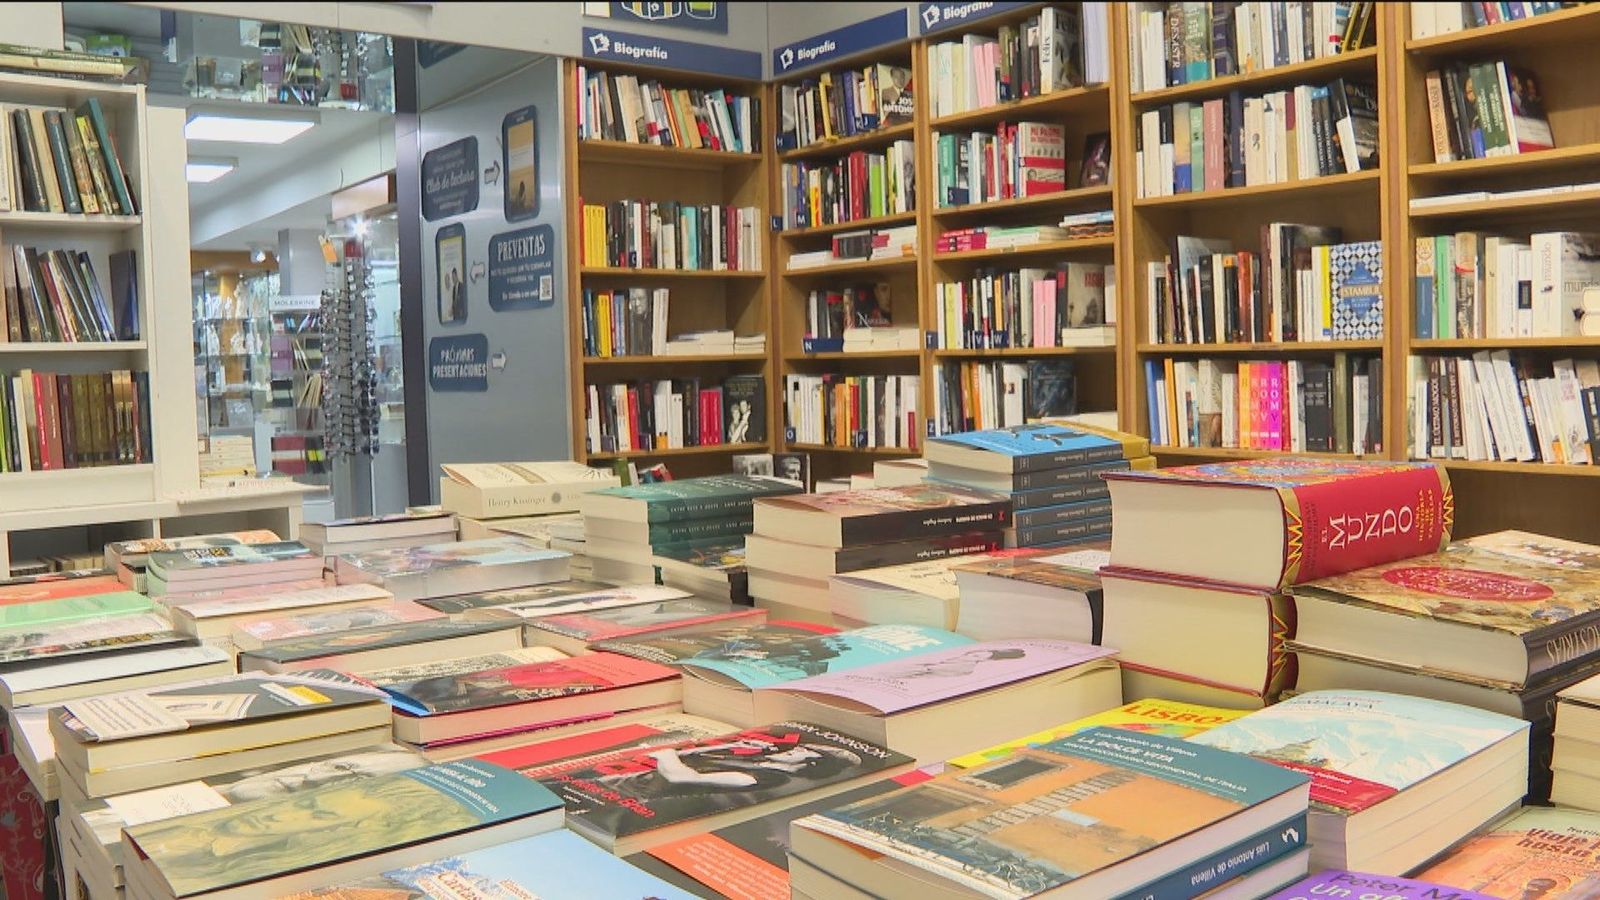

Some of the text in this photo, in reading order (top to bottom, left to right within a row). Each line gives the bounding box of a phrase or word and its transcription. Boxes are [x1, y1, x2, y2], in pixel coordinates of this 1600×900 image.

[614, 41, 668, 60] Biografía
[797, 40, 836, 61] Biografía
[883, 103, 914, 112] ANTONI
[898, 97, 912, 105] JOS
[777, 137, 783, 146] H
[773, 218, 778, 228] L
[797, 215, 806, 224] M
[497, 234, 546, 261] PREVENTAS
[805, 341, 812, 350] N
[927, 335, 932, 344] T
[995, 334, 1003, 344] W
[432, 363, 487, 378] PRESENTACIONES
[928, 423, 935, 433] Z
[488, 497, 510, 507] Henry
[1329, 505, 1413, 550] MUNDO
[1321, 528, 1327, 543] EL
[1123, 704, 1225, 724] LISBO
[1143, 750, 1175, 764] VITA
[1191, 841, 1270, 886] Luis Antonio de Villena
[1328, 873, 1417, 892] Peter
[1310, 882, 1352, 898] Un
